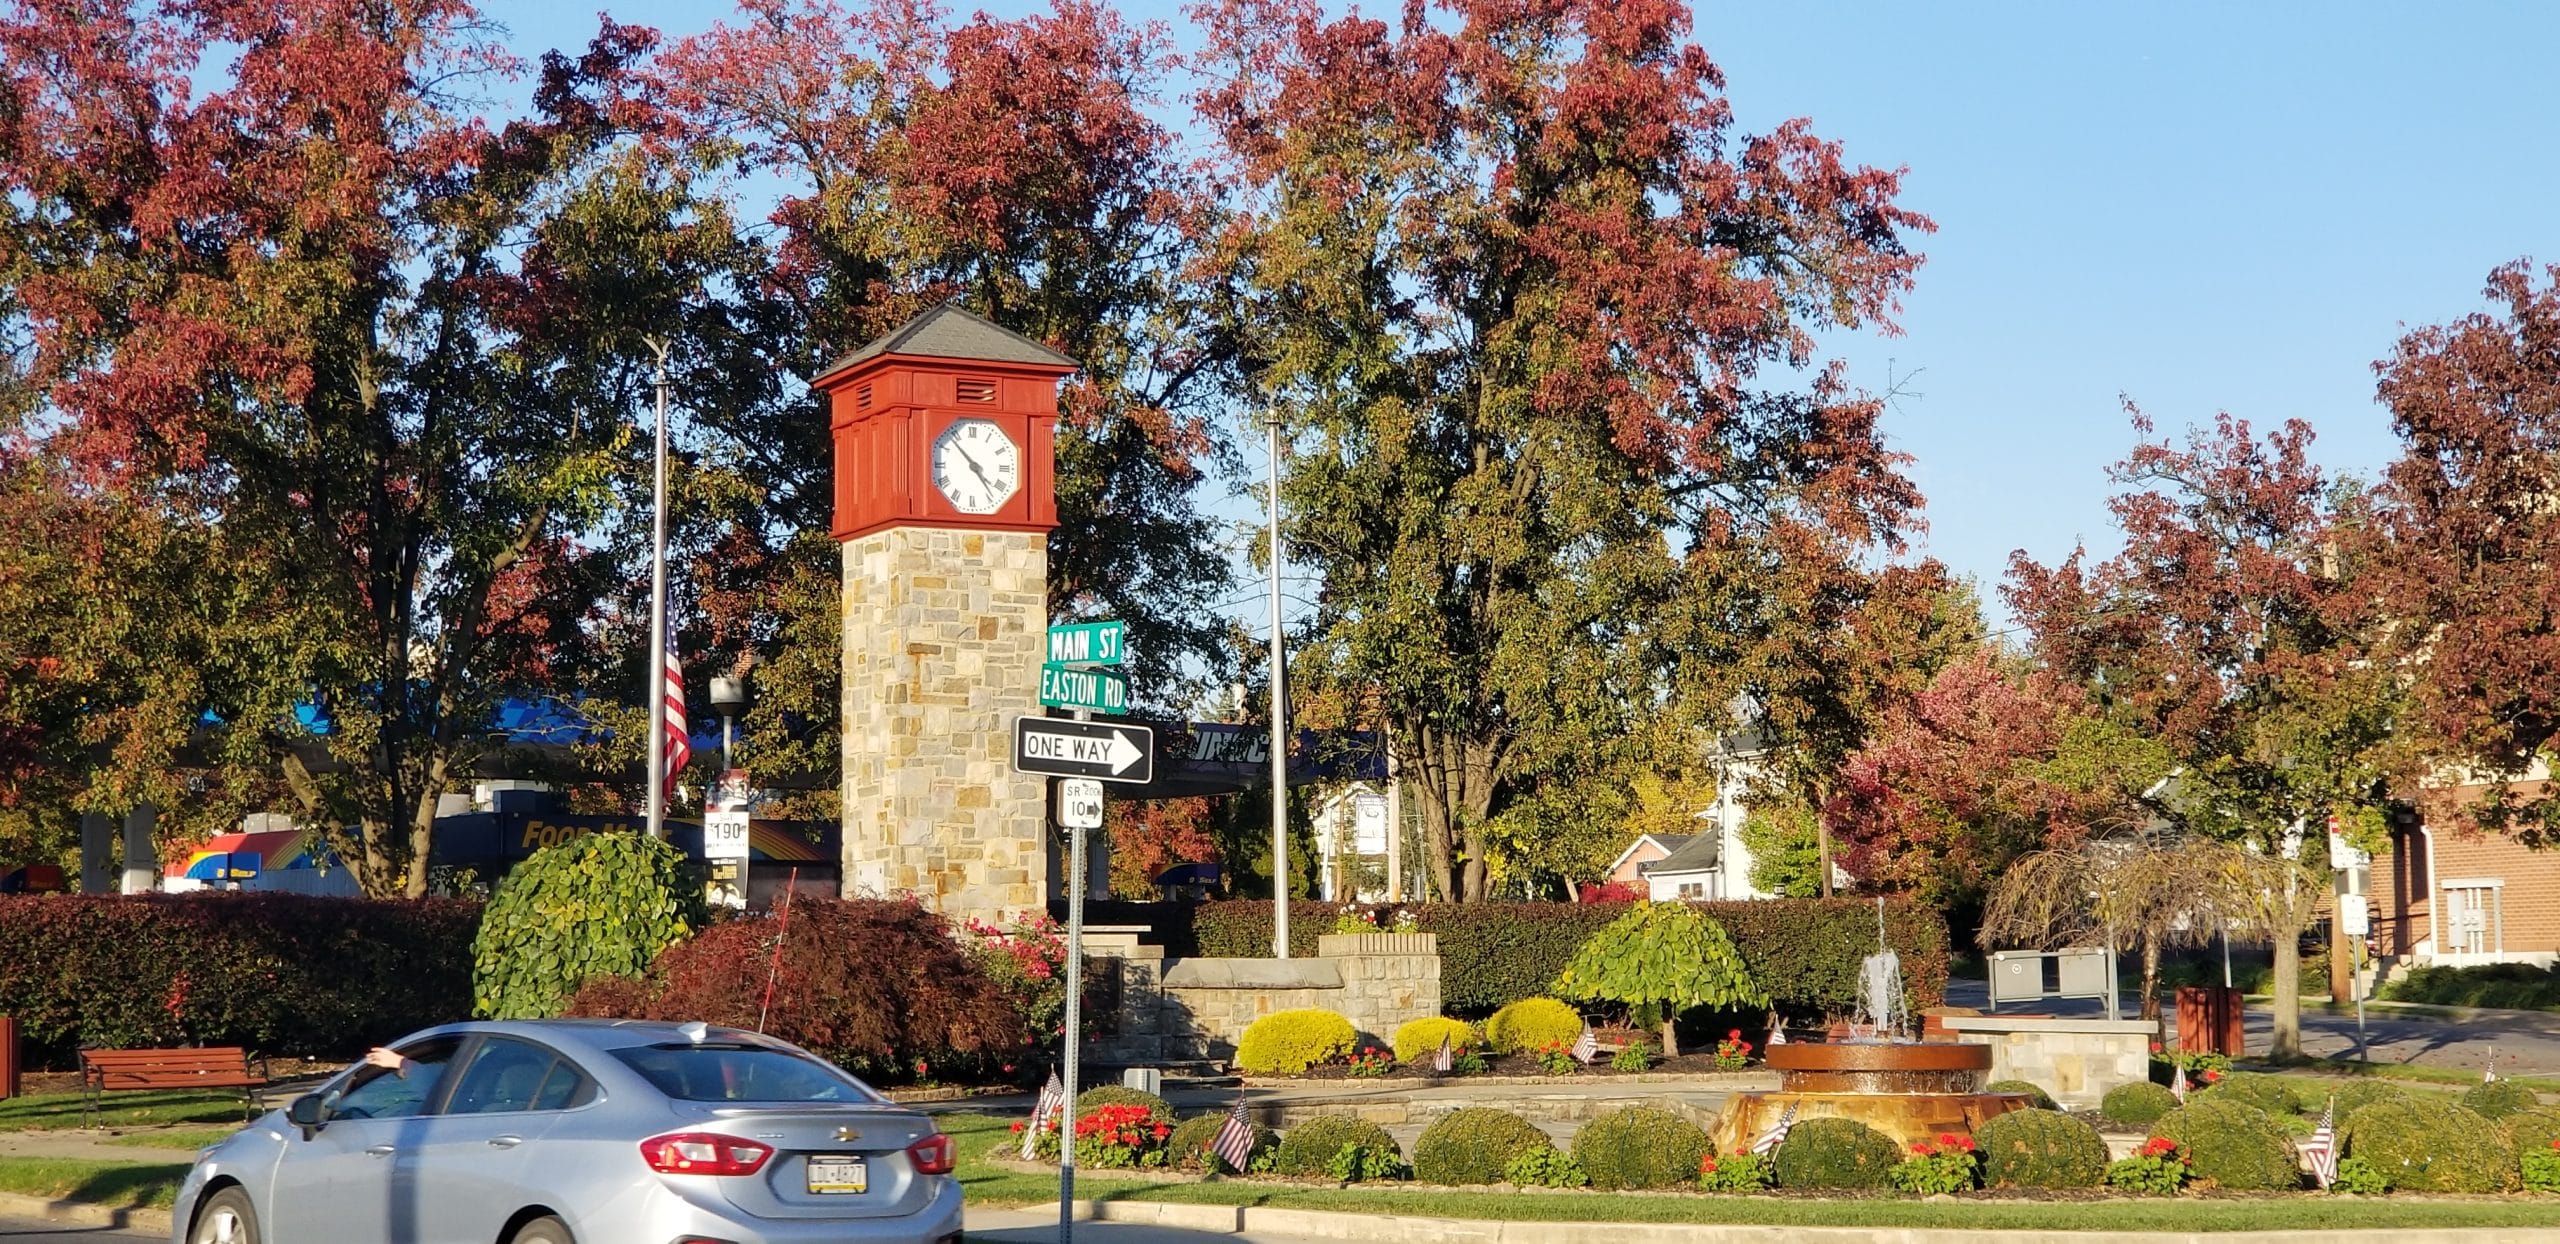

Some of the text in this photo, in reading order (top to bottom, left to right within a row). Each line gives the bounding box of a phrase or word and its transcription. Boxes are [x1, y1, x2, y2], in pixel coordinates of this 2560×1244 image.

[1051, 627, 1119, 662] MAIN ST
[1042, 669, 1124, 709] EASTON RD
[1028, 735, 1113, 762] ONE WAY
[1067, 786, 1081, 797] SR
[1072, 801, 1086, 816] 10
